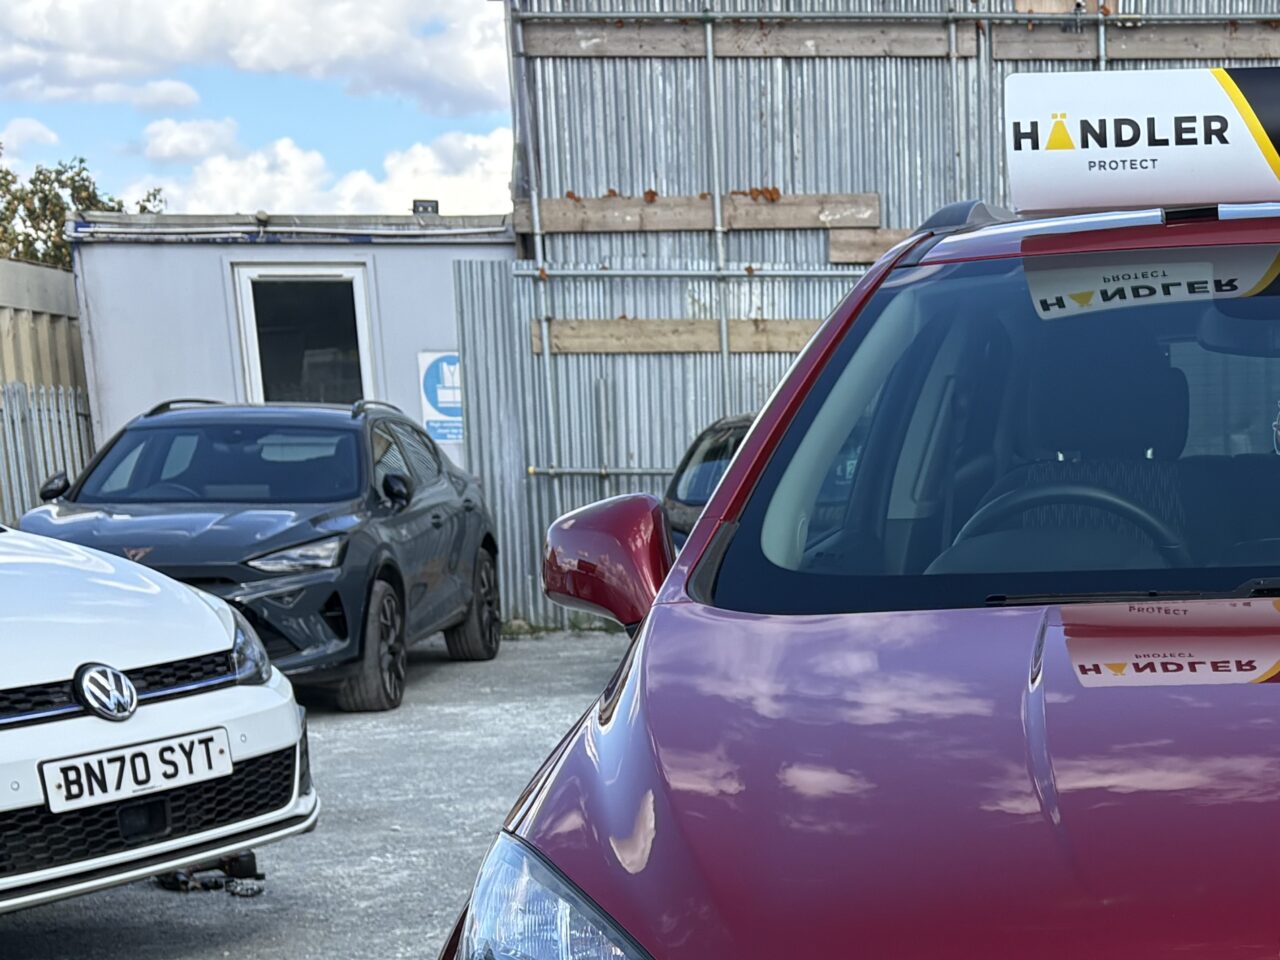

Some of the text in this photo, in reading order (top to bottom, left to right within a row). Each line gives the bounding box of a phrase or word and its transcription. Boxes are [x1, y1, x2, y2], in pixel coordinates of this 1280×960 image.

[1088, 158, 1159, 171] PROTECT
[59, 736, 215, 801] BN70 SYT
